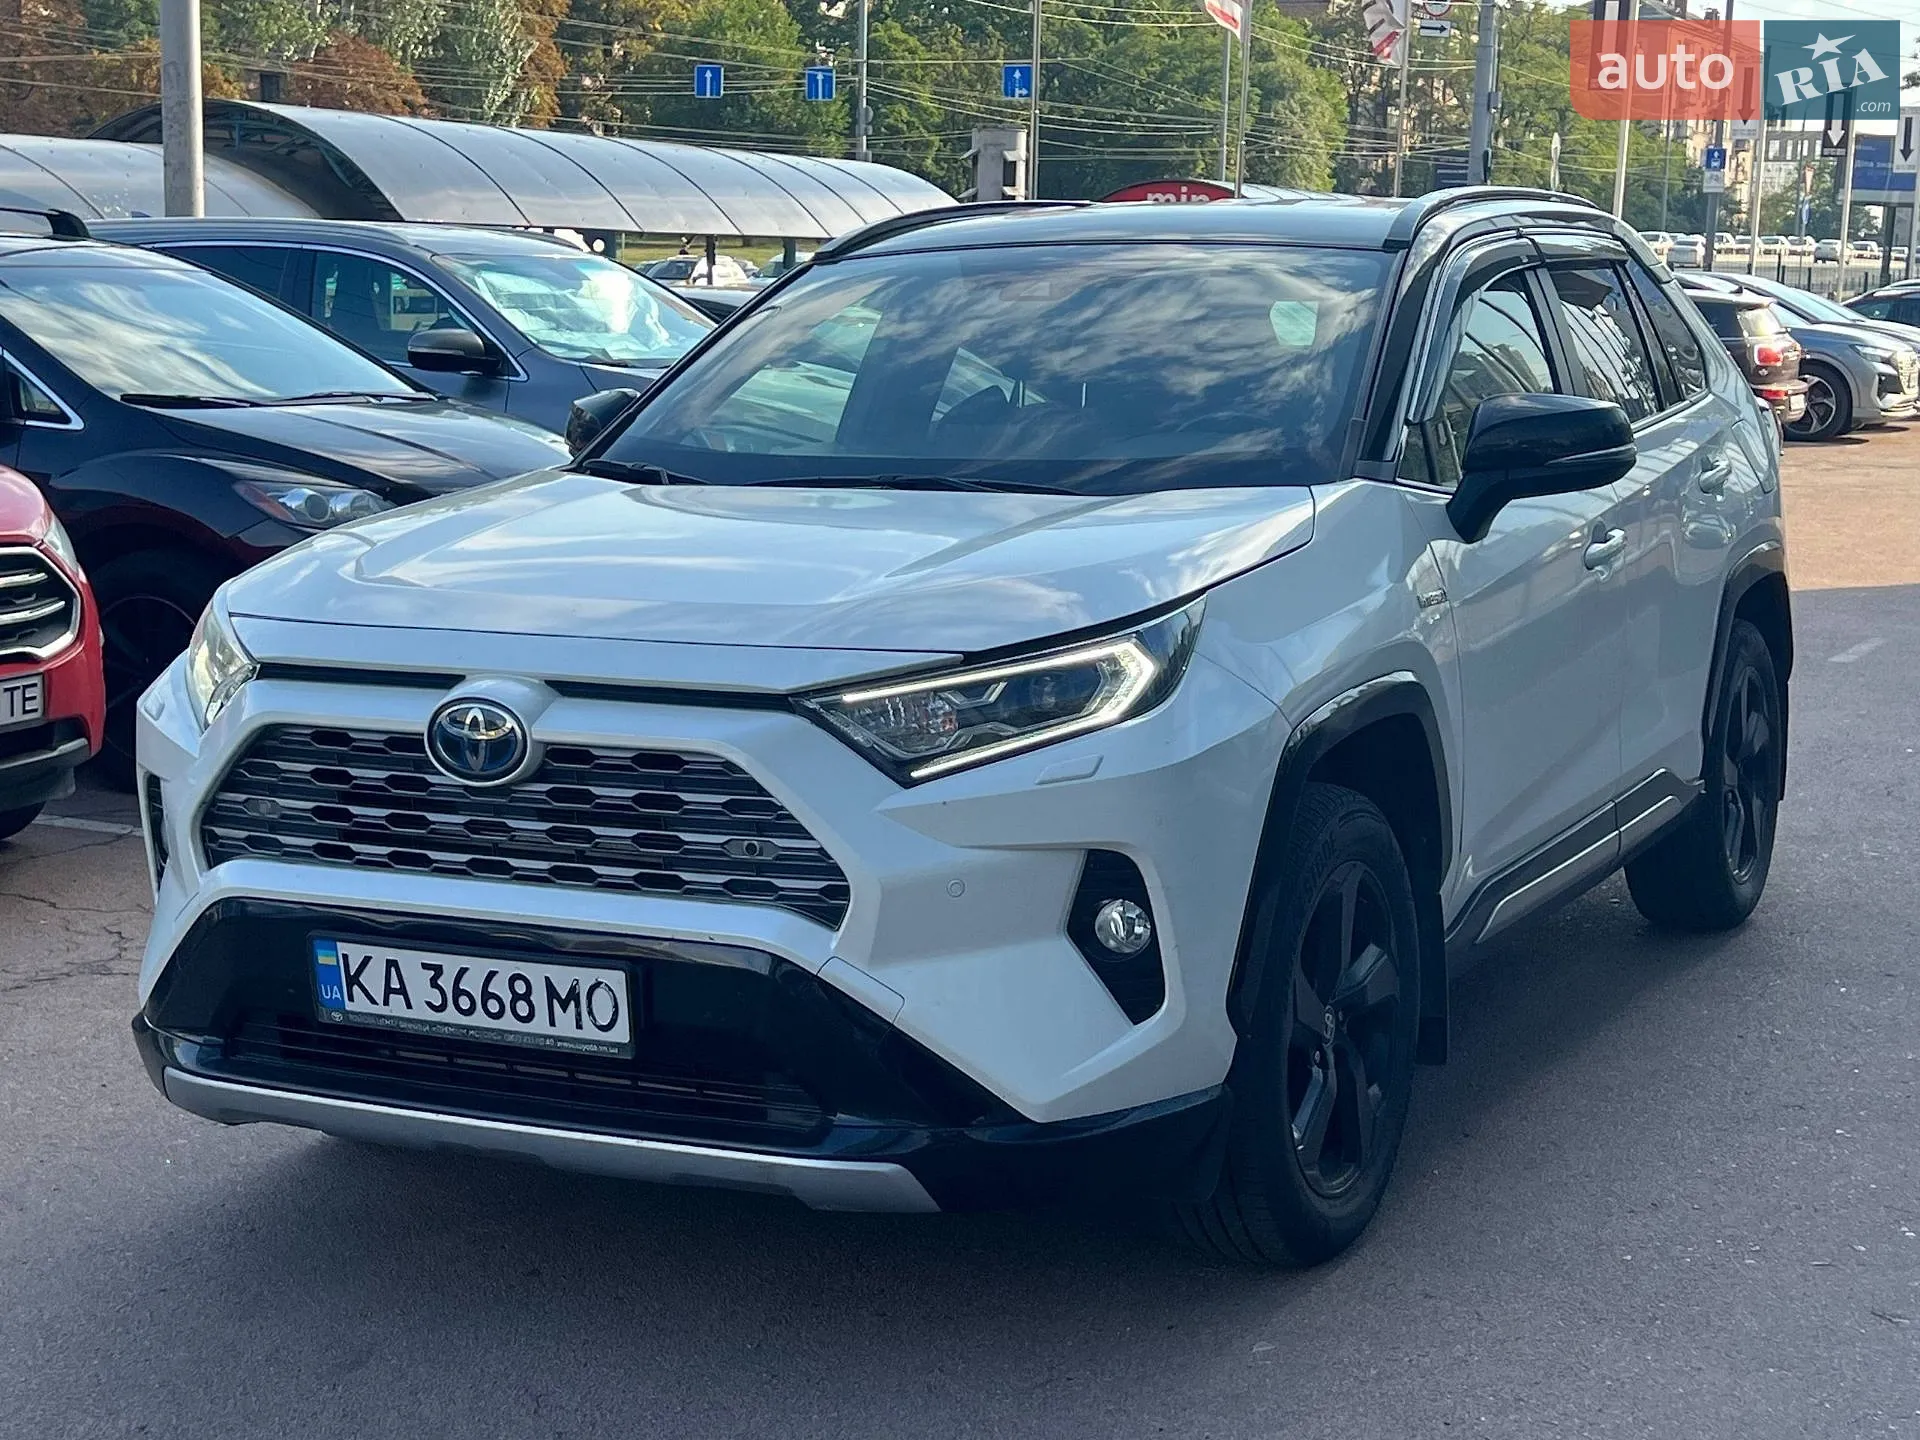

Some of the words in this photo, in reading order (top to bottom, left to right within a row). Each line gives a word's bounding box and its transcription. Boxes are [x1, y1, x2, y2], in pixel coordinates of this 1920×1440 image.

[3, 682, 39, 718] TE
[320, 983, 342, 1001] UA
[341, 952, 414, 1010] KA
[420, 961, 536, 1024] 3668
[544, 975, 620, 1033] MO
